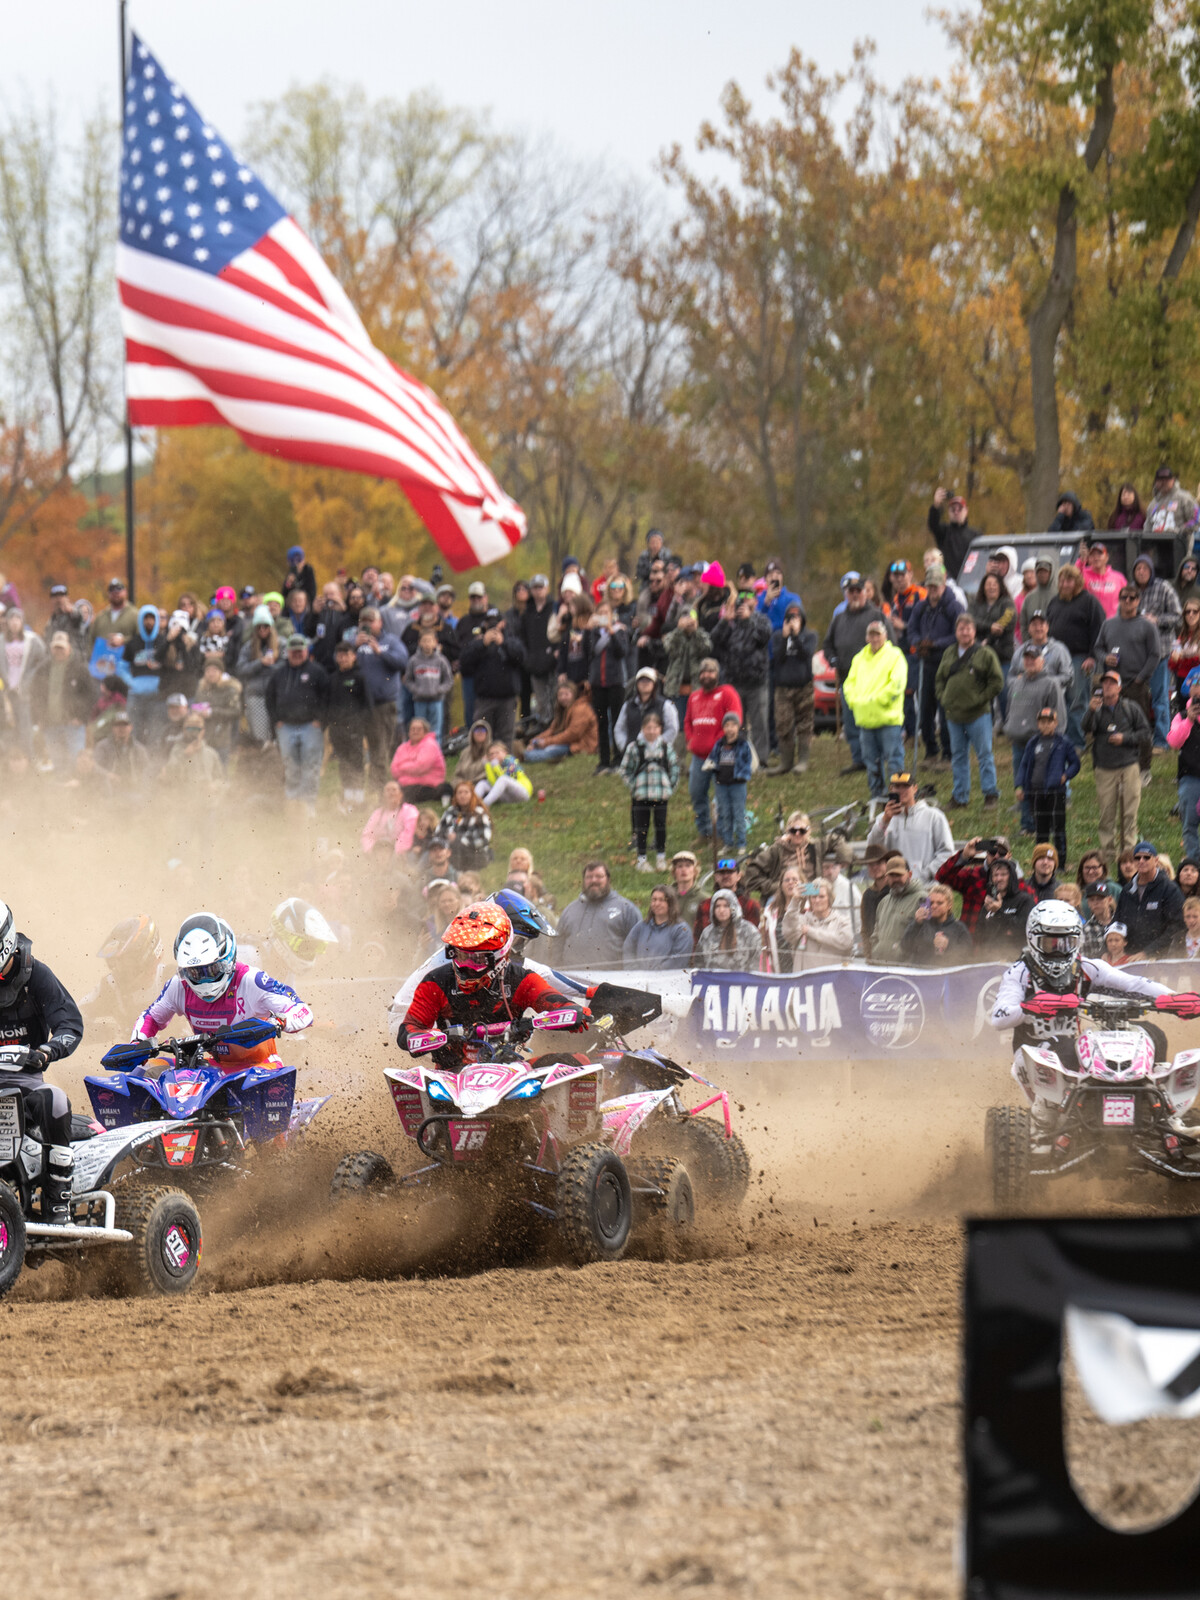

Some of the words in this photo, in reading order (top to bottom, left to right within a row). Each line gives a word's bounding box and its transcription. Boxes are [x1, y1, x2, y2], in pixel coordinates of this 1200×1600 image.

[558, 1013, 573, 1023] 18
[409, 1039, 422, 1049] 18
[696, 1036, 831, 1048] CING
[1078, 1036, 1091, 1060] CST
[467, 1072, 496, 1085] 18
[1103, 1102, 1135, 1120] 223
[170, 1134, 192, 1163] 1
[455, 1131, 487, 1150] 18
[166, 1229, 188, 1264] 703
